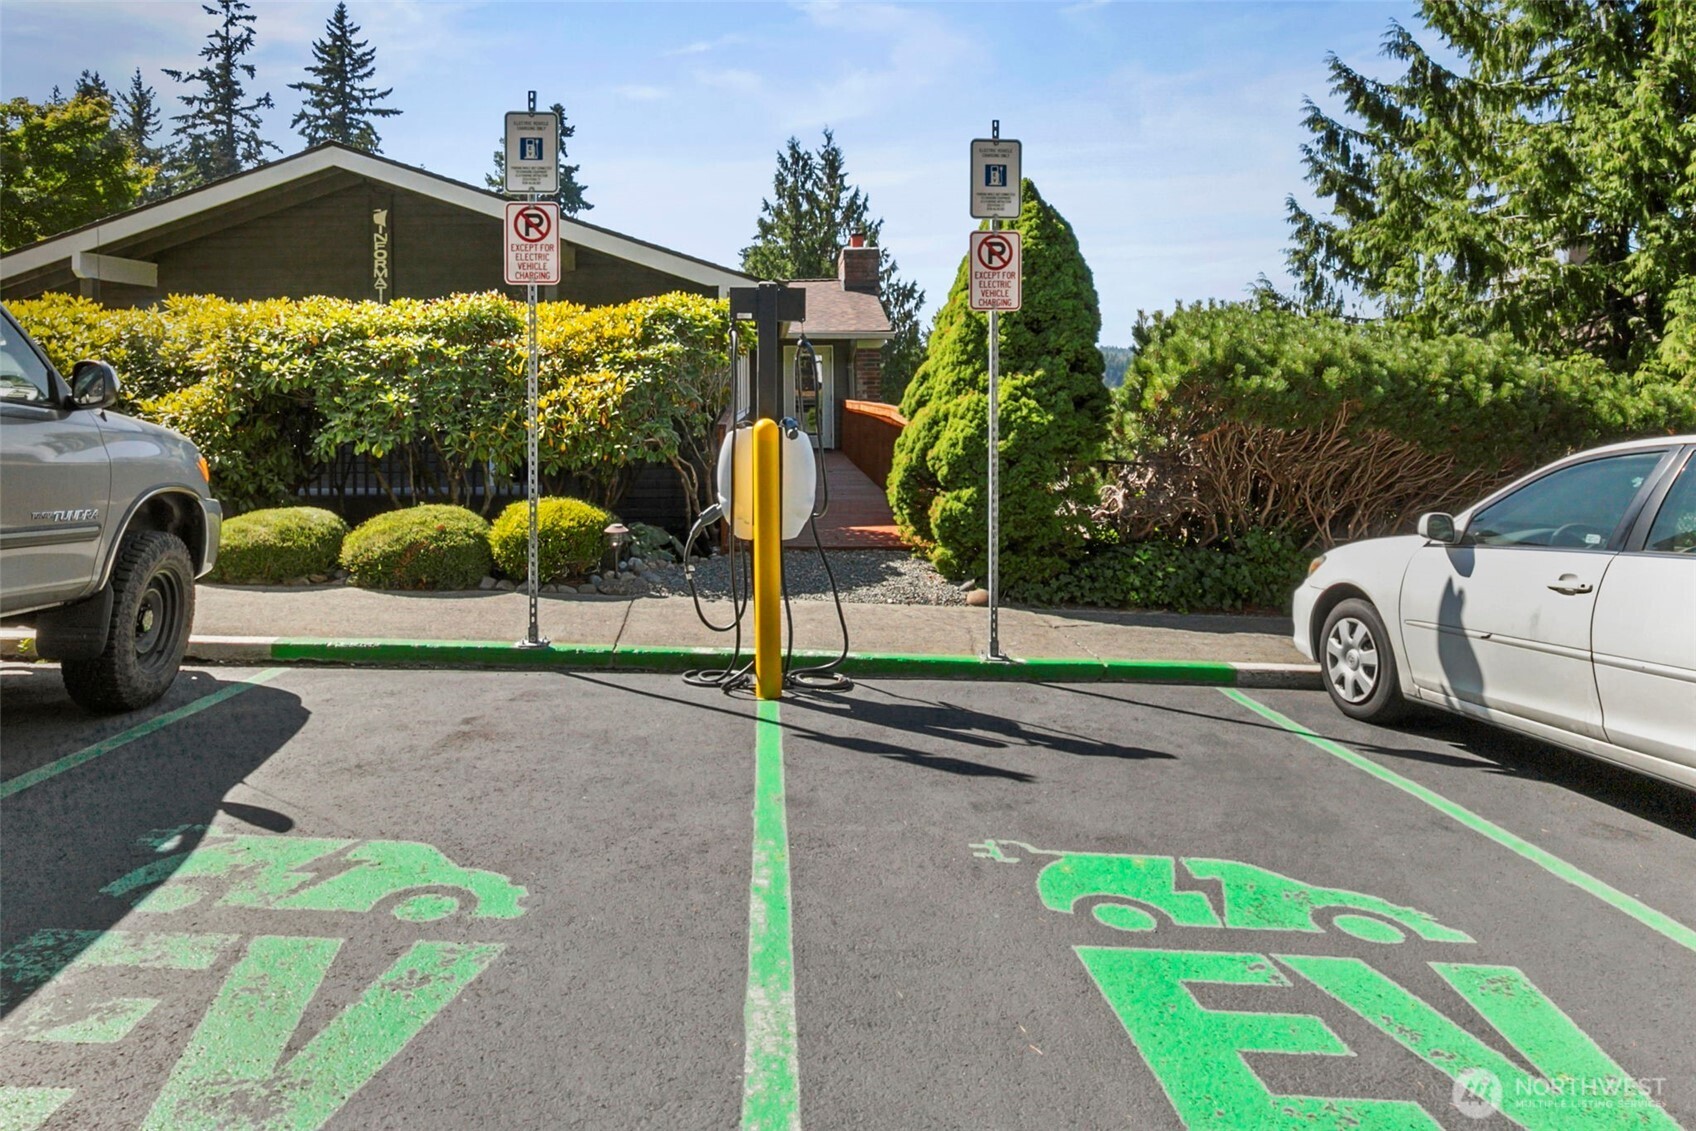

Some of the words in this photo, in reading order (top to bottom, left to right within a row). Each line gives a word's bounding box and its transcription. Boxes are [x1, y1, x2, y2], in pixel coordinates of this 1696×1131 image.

[525, 213, 544, 236] P
[510, 244, 538, 252] EXCEPT
[539, 244, 555, 252] FOR
[515, 253, 550, 261] ELECTRIC
[988, 242, 1006, 265] P
[517, 262, 548, 270] VEHICLE
[514, 271, 551, 280] CHARGING
[974, 271, 1001, 280] EXCEPT
[1002, 271, 1016, 280] FOR
[978, 280, 1012, 289] ELECTRIC
[980, 289, 1010, 298] VEHICLE
[978, 298, 1012, 307] CHARGING
[53, 508, 99, 522] TUNDRA
[1072, 945, 1686, 1131] EV
